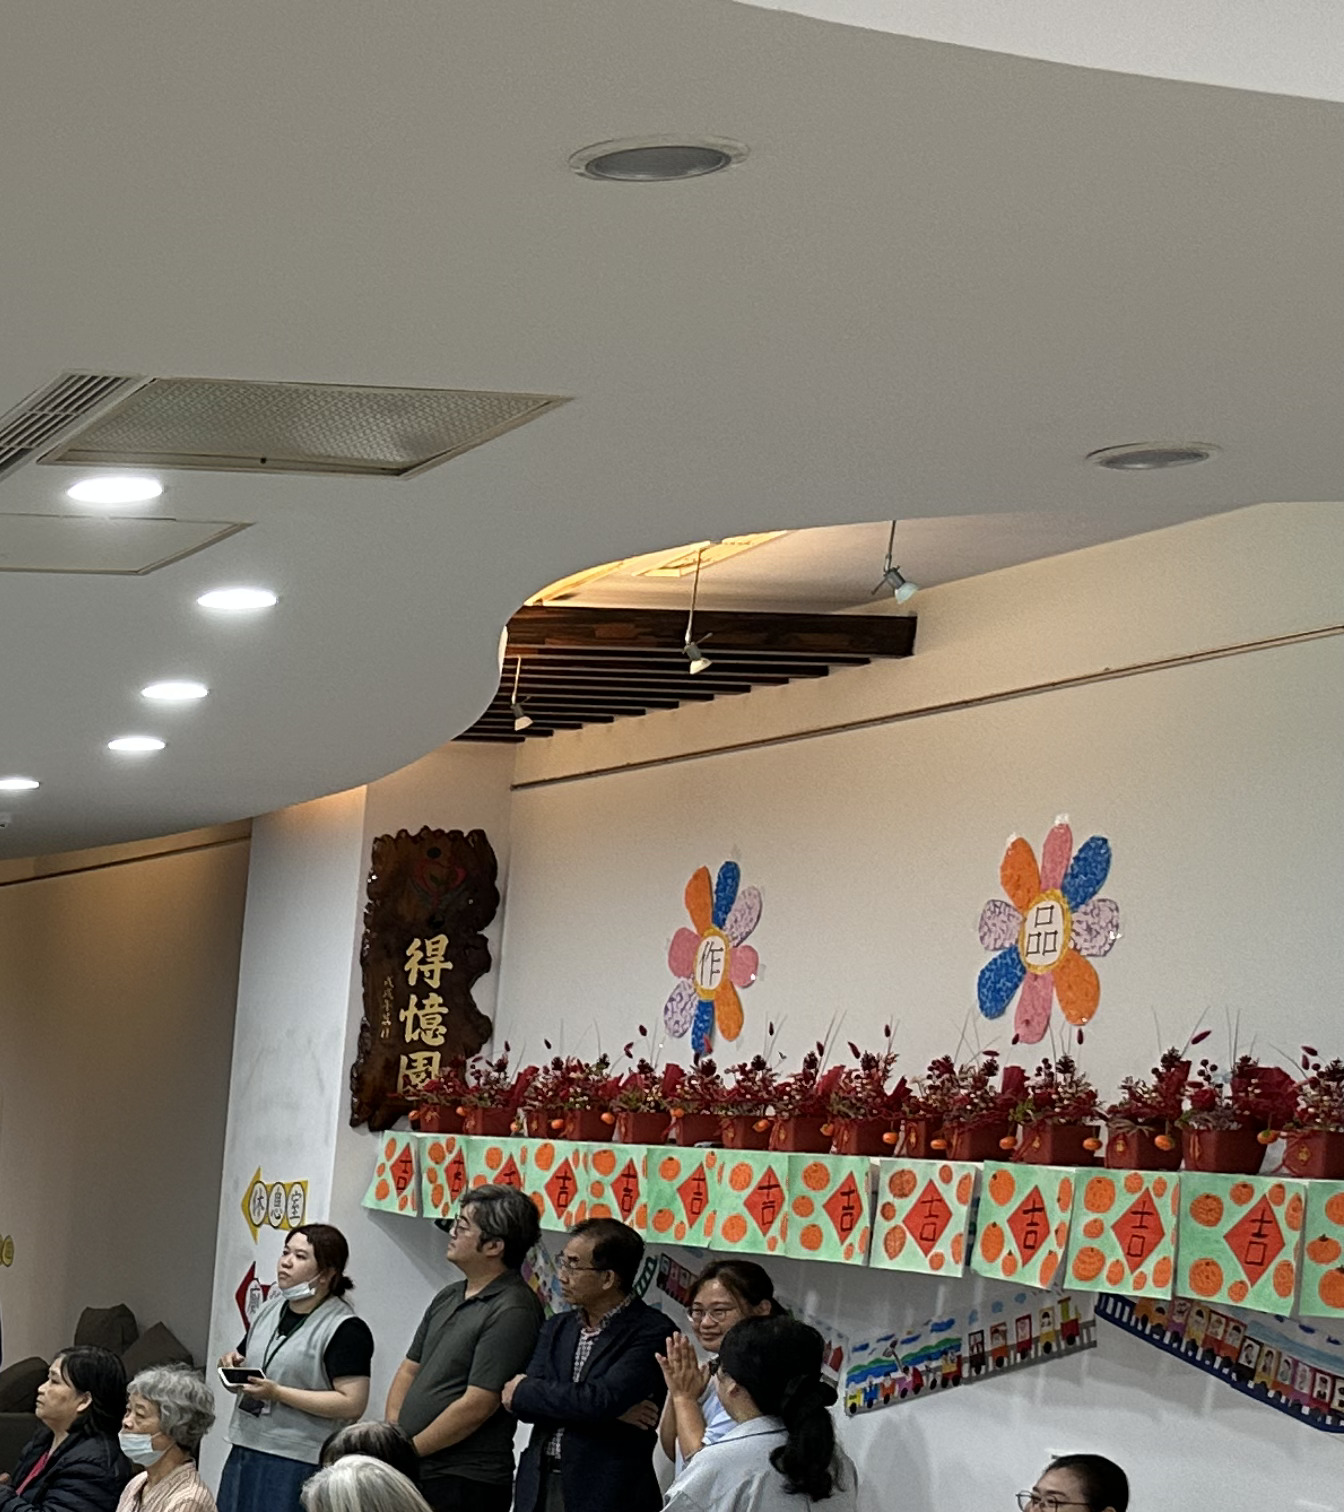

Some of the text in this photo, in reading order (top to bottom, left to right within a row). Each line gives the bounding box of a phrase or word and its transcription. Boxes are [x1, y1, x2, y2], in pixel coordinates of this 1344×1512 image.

[1025, 904, 1059, 957] 品
[698, 941, 725, 987] 作
[397, 933, 454, 1097] 得憶園
[555, 1170, 572, 1208] 吉
[620, 1164, 637, 1213] 吉
[691, 1168, 706, 1216] 吉
[758, 1175, 781, 1226] 吉
[839, 1184, 856, 1233] 吉
[919, 1195, 942, 1242] 吉
[1022, 1198, 1044, 1251] 吉
[1127, 1200, 1154, 1258] 吉
[1245, 1208, 1273, 1267] 吉
